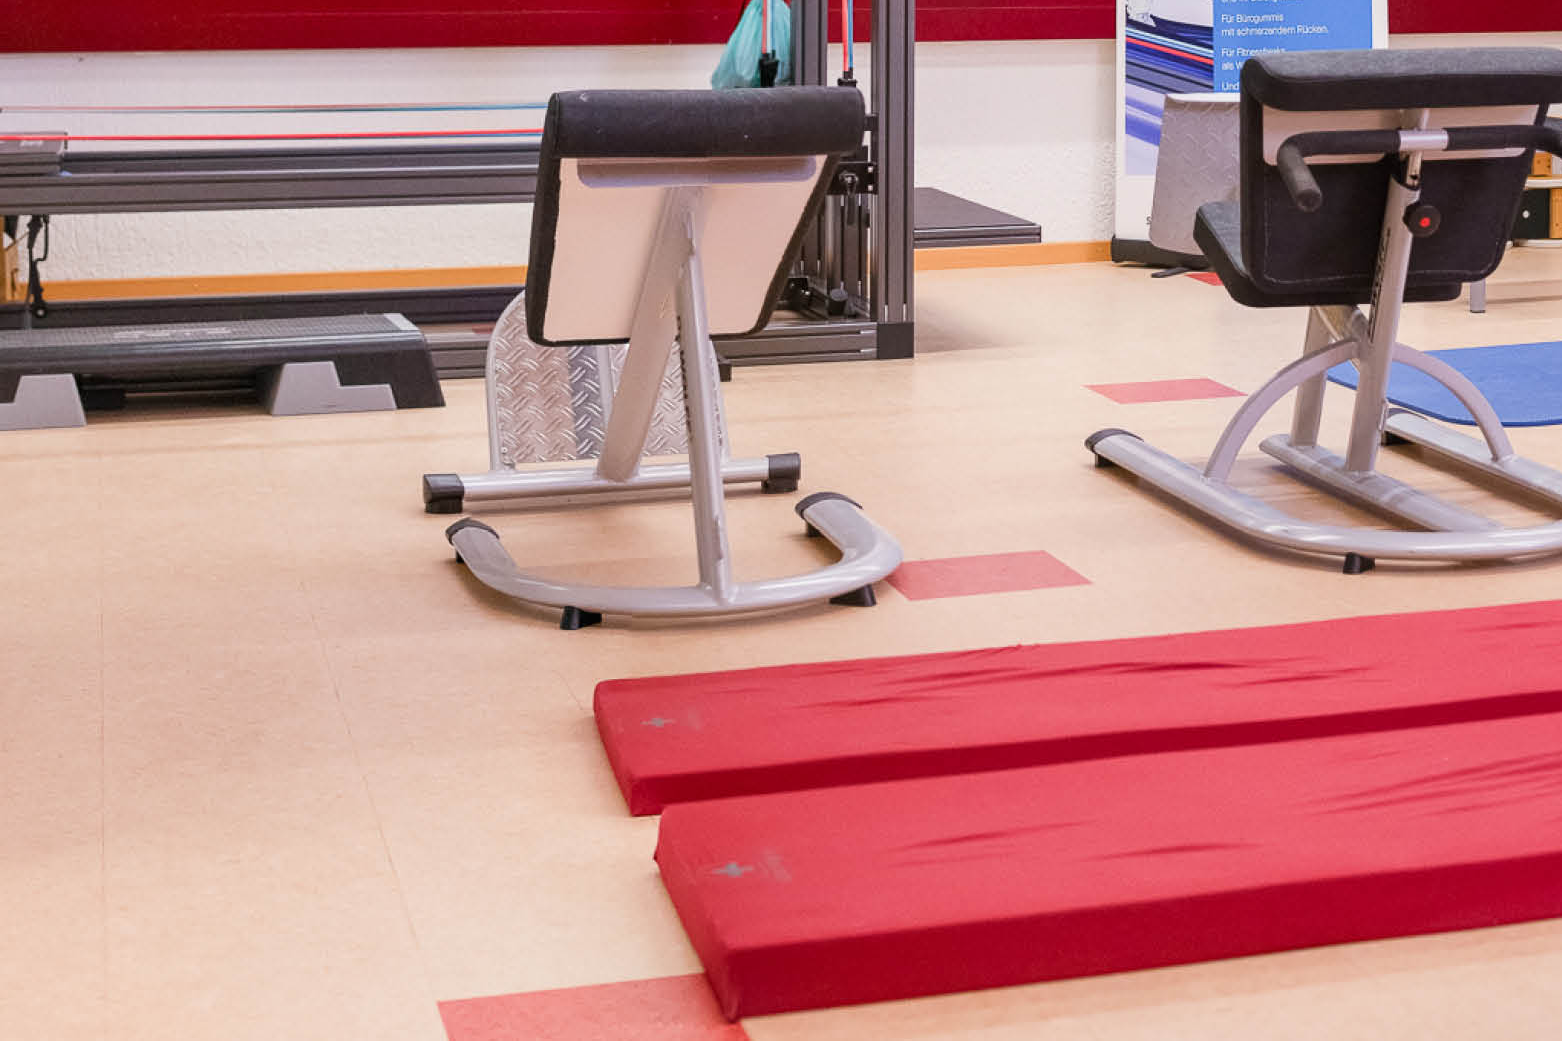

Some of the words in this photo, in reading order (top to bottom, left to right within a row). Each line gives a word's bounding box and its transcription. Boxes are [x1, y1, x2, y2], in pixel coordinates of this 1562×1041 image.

[1221, 13, 1235, 23] Für
[1236, 12, 1284, 24] Bürogummis
[1221, 47, 1235, 57] Für
